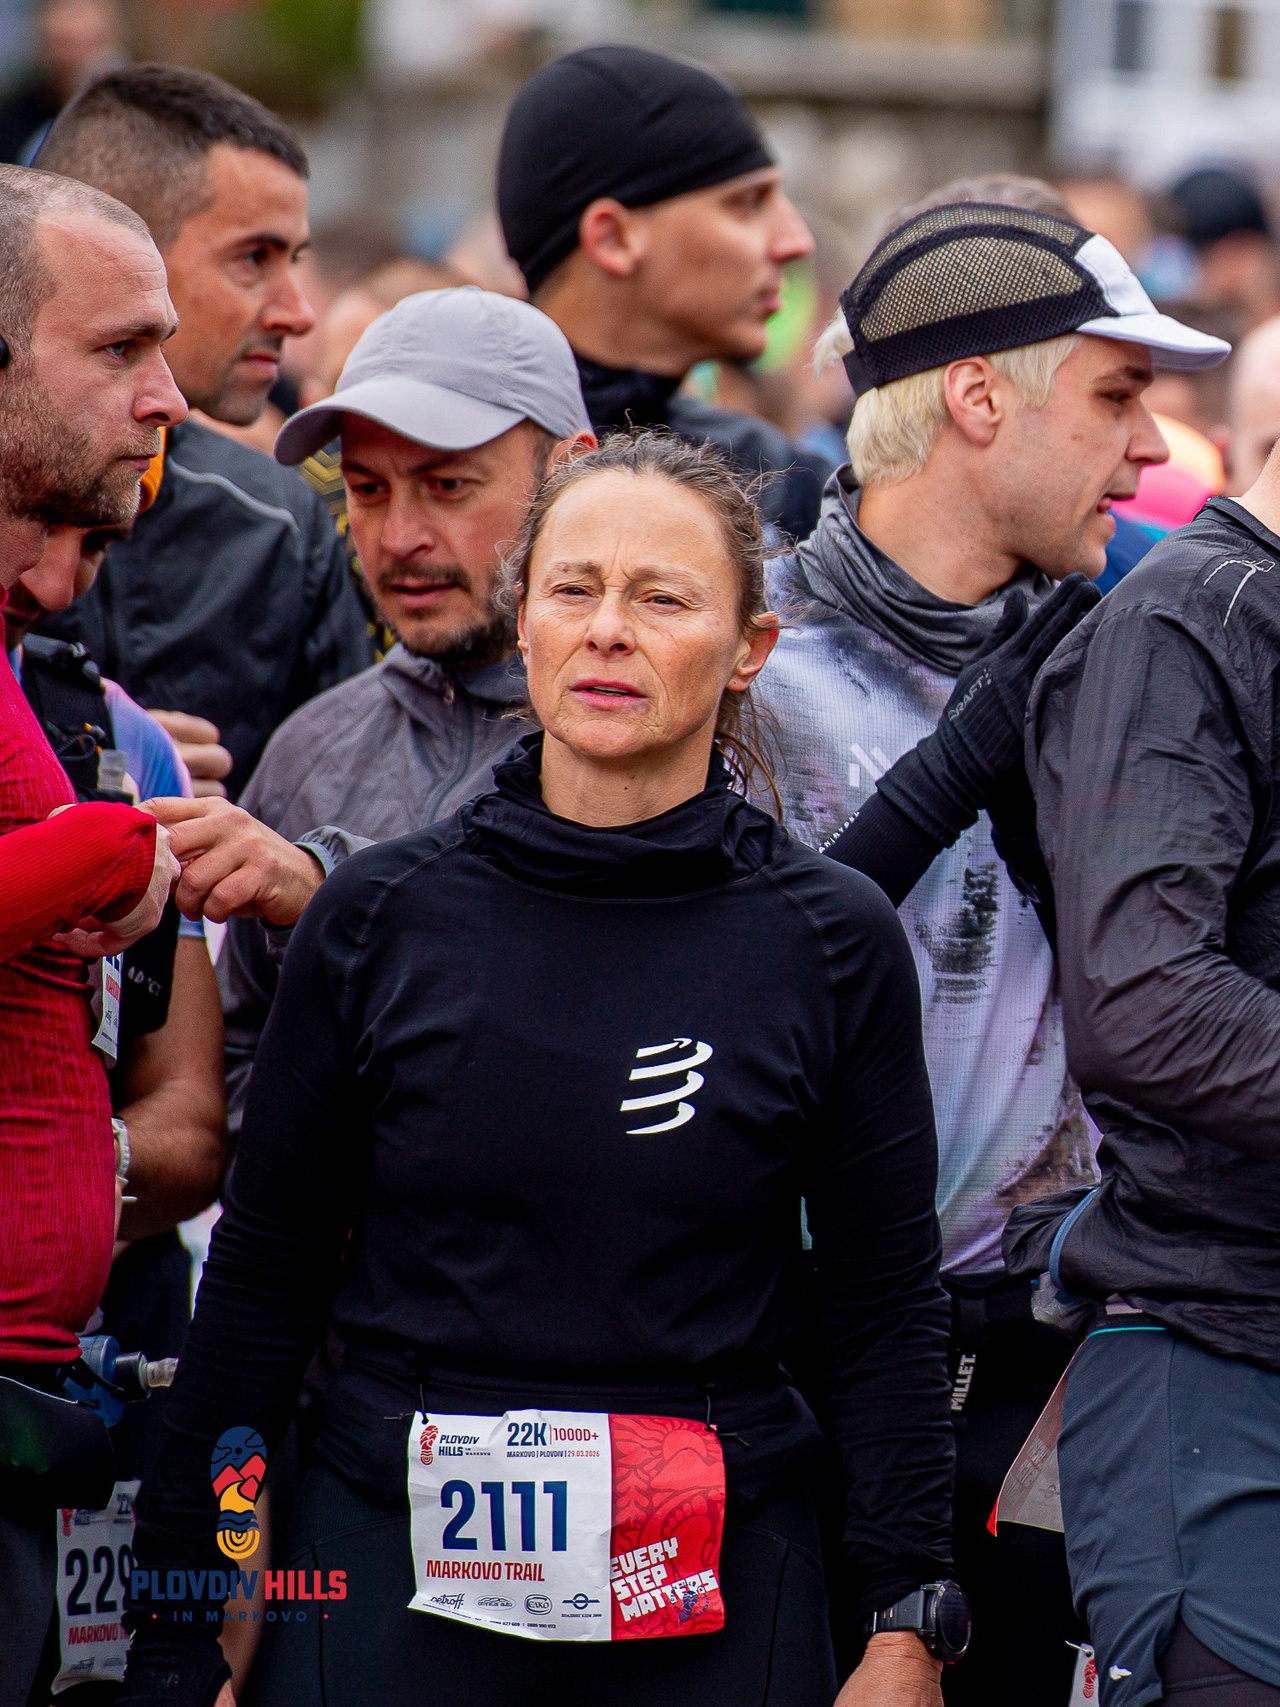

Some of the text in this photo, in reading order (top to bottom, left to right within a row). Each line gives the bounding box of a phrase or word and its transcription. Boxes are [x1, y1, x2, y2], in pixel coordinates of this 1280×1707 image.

[947, 675, 985, 721] CRAFT
[439, 1434, 480, 1444] PLOVDIV
[507, 1422, 600, 1446] 22K 1000D+
[438, 1446, 464, 1456] HILLS
[507, 1450, 600, 1458] MARKOVO PLOVDIV 29.03.2026
[441, 1479, 568, 1551] 2111
[427, 1559, 546, 1582] MARKOVO TRAIL
[610, 1537, 679, 1580] EVERY
[611, 1564, 668, 1601] STEP
[619, 1569, 719, 1622] MATTERS
[68, 1623, 119, 1645] MARKOVO
